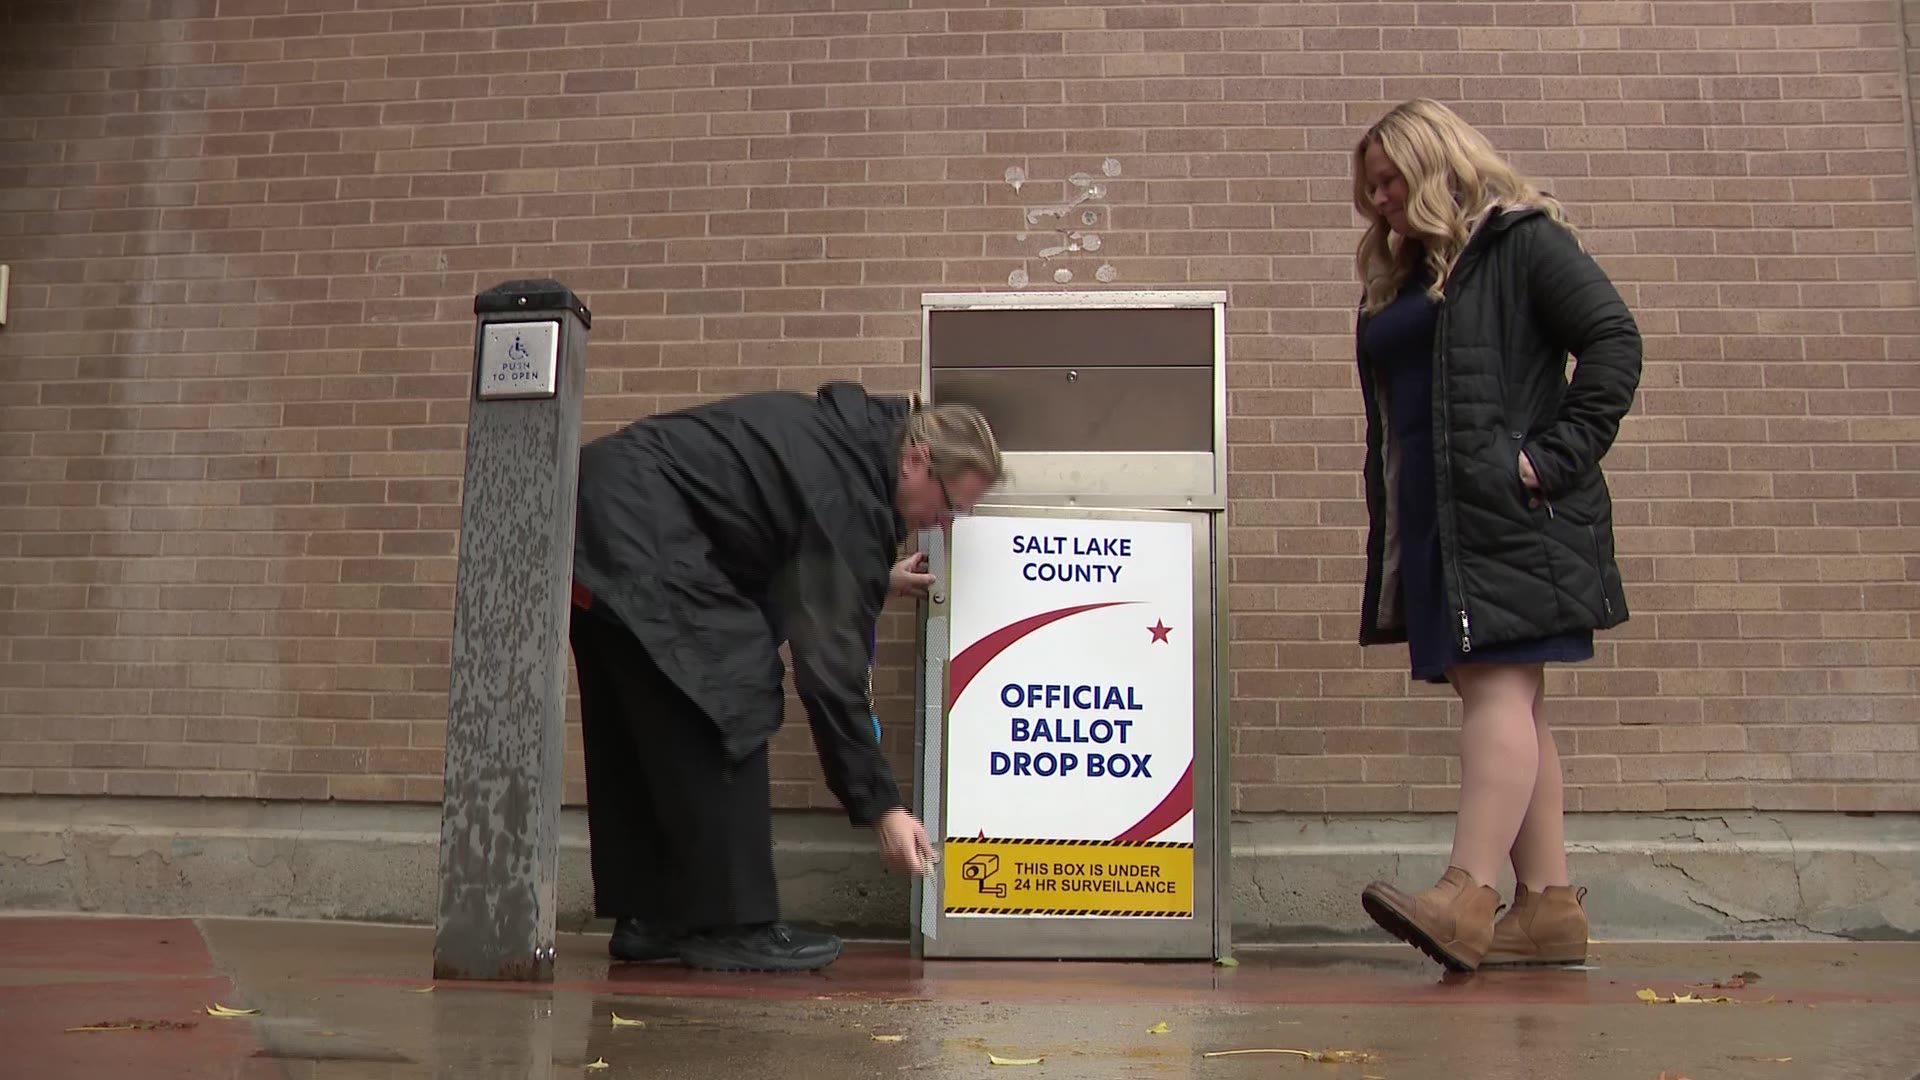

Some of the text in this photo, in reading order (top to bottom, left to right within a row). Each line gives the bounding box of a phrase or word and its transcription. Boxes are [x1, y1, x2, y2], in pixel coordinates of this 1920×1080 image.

[493, 371, 538, 381] TO OPEN
[502, 362, 530, 371] PUSH
[1012, 535, 1131, 556] SALT LAKE
[1022, 563, 1122, 583] COUNTY
[1000, 683, 1143, 710] OFFICIAL
[1011, 718, 1133, 743] BALLOT
[990, 751, 1152, 778] DROP BOX
[1014, 862, 1160, 877] THIS BOX IS UNDER
[1014, 878, 1176, 893] 24 HR SURVEILLANCE
